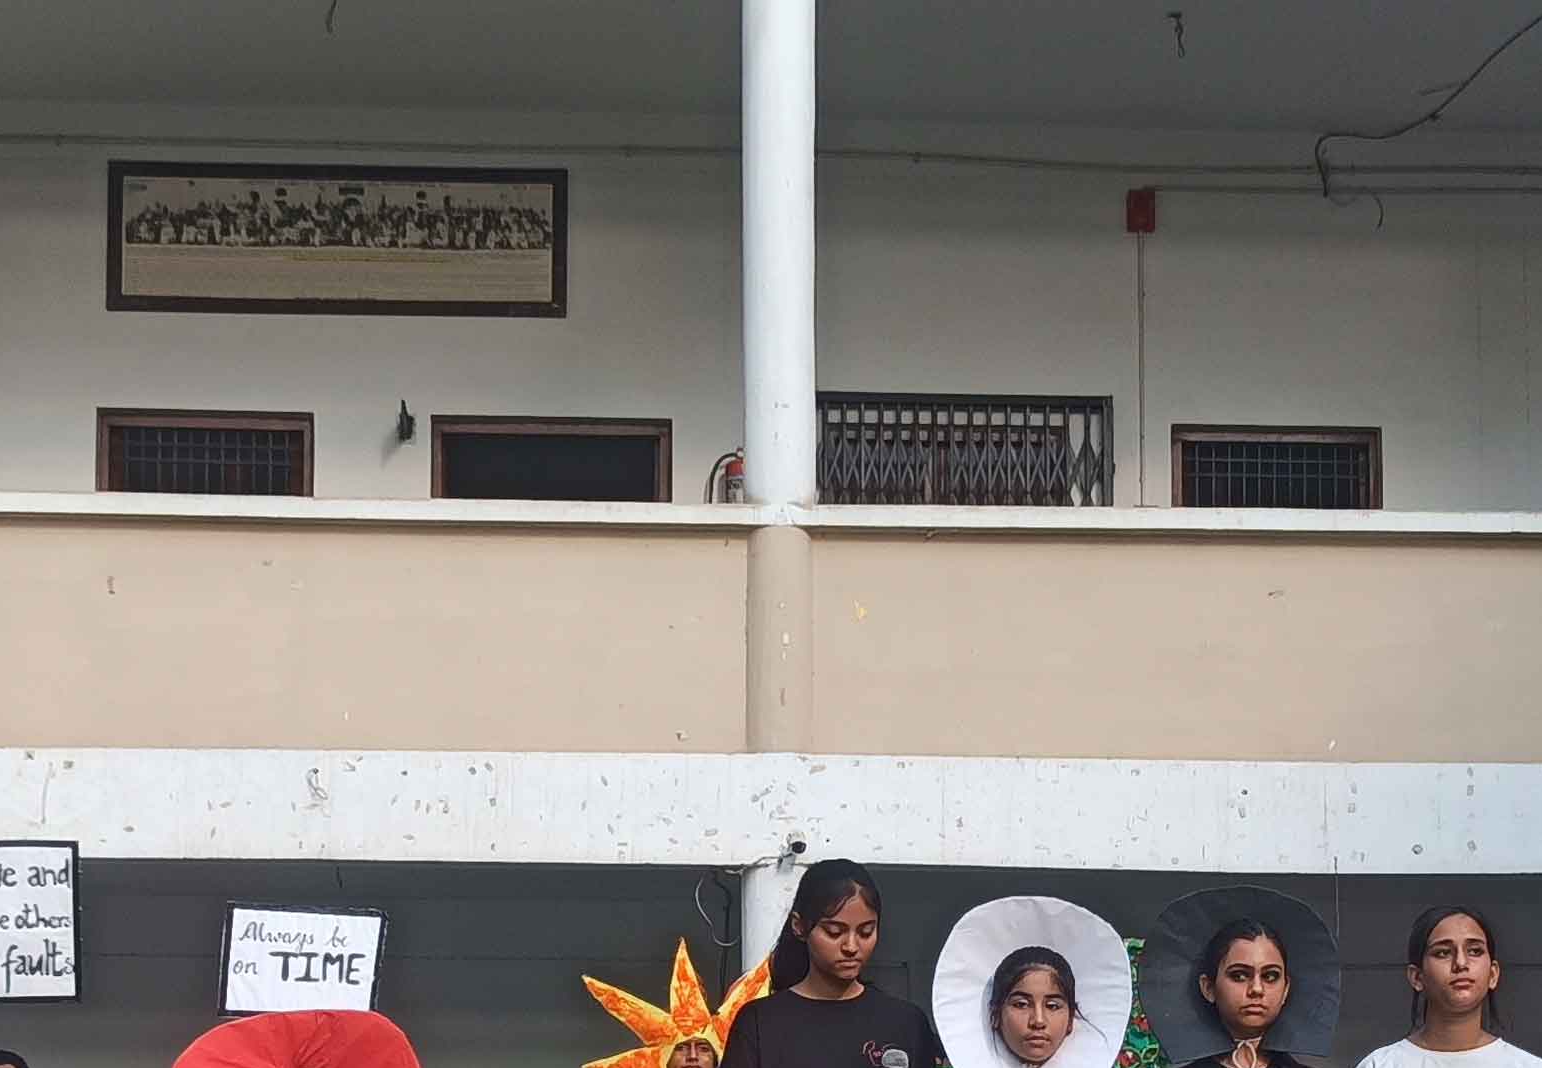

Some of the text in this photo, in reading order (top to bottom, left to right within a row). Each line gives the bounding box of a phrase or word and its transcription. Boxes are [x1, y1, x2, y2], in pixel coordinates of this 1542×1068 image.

[27, 858, 71, 888] and
[14, 903, 72, 929] others
[238, 921, 348, 951] Always be
[1, 937, 76, 993] faults
[233, 951, 366, 985] on TIME
